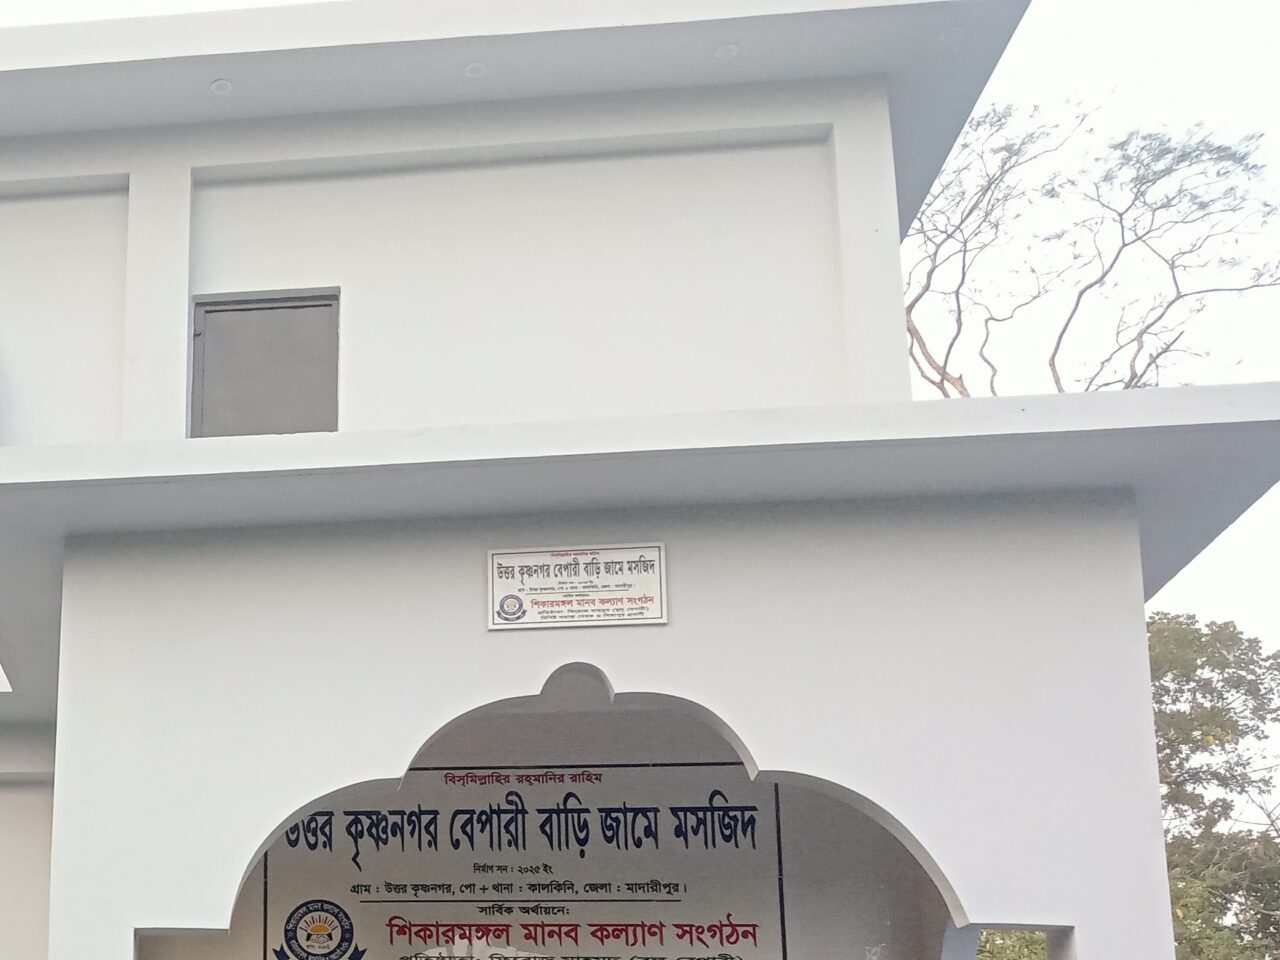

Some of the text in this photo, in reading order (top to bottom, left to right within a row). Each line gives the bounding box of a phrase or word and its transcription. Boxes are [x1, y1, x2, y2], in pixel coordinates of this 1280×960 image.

[553, 557, 580, 578] বেপারী
[582, 556, 601, 579] বাড়ি
[603, 559, 624, 576] জামে
[626, 554, 656, 575] মসজিদ
[343, 803, 441, 872] কৃষ্ণনগর
[449, 790, 529, 852] বেপারী
[536, 791, 591, 858] বাড়ি
[597, 801, 660, 850] জামে
[669, 789, 759, 850] মসজিদ
[350, 881, 370, 895] গ্রাম
[384, 881, 408, 895] উত্তর
[459, 882, 476, 895] পো
[491, 882, 513, 895] থানা
[583, 883, 612, 895] জেলা
[477, 903, 514, 916] সার্বিক
[385, 914, 513, 947] শিকারমঙ্গল
[520, 920, 581, 948] মানব
[587, 920, 667, 947] কল্যাণ
[672, 912, 759, 949] সংগঠন
